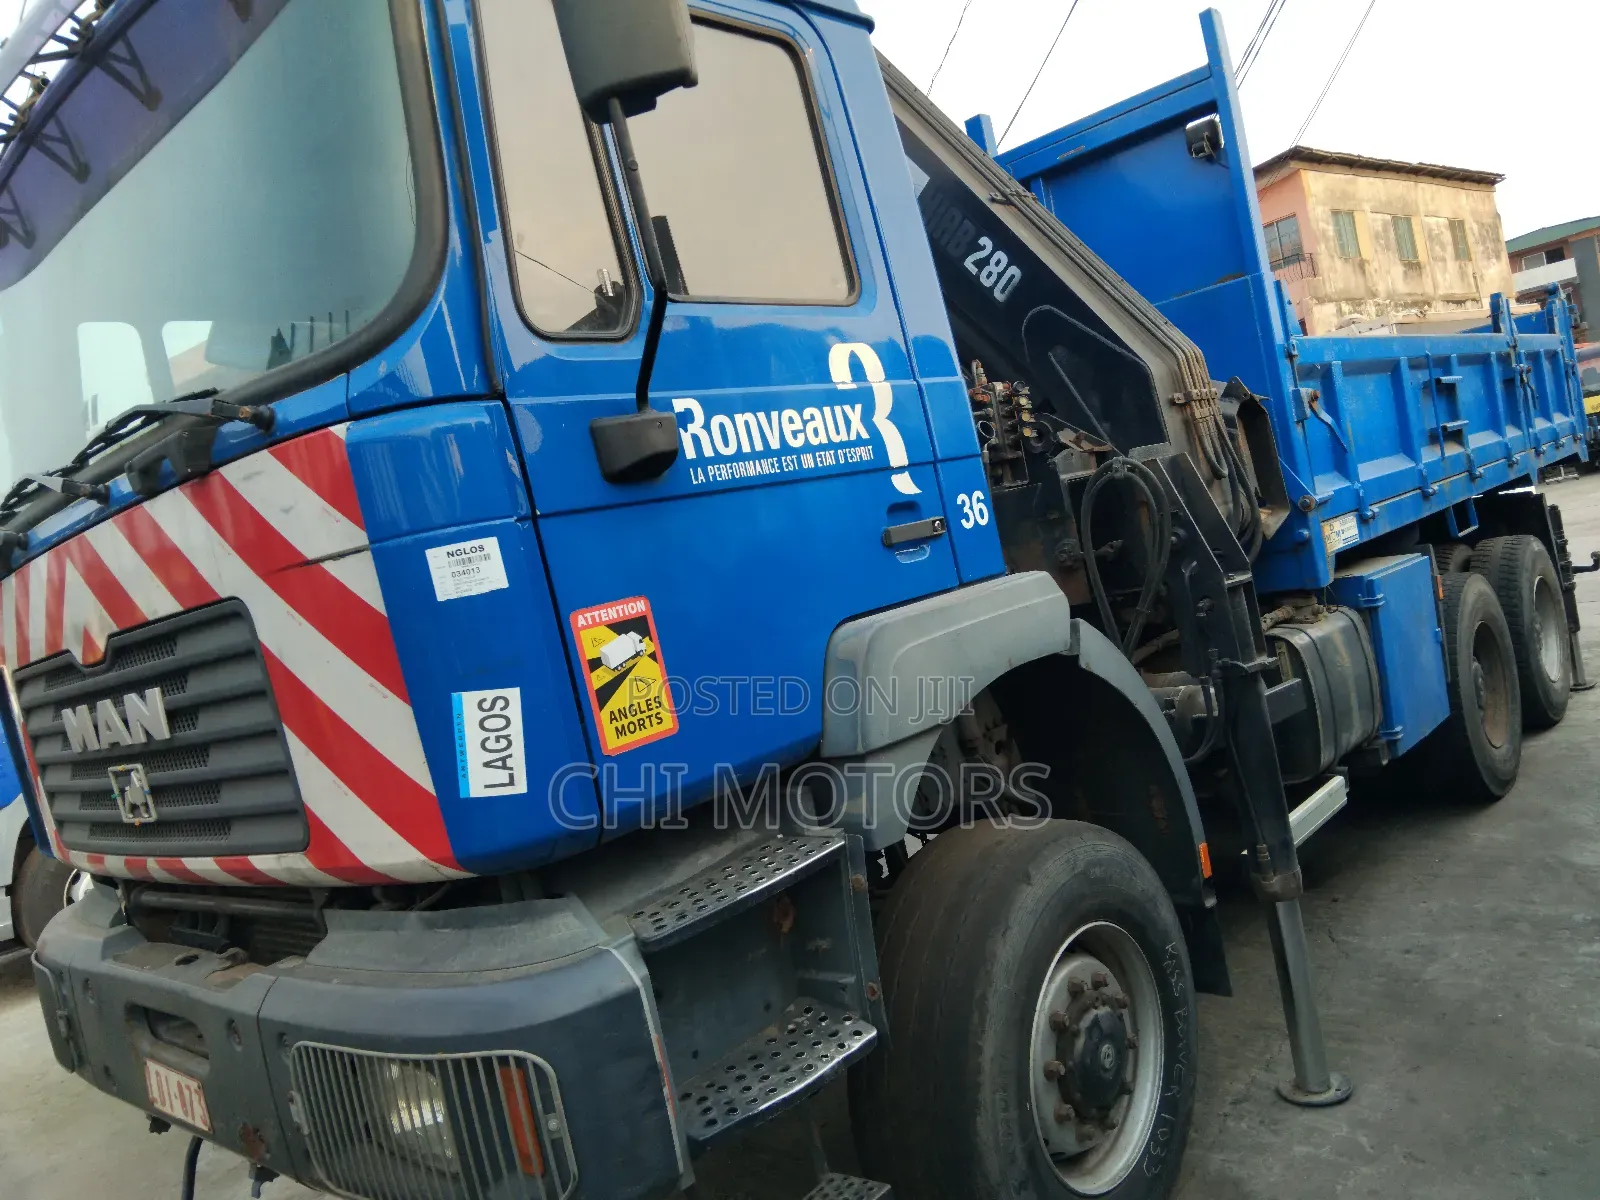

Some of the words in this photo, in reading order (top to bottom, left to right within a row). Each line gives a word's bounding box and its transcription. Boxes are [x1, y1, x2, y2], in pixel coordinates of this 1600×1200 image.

[963, 236, 1022, 302] 280
[671, 397, 871, 460] Ronveaux
[690, 466, 706, 485] LA
[708, 457, 780, 483] PERFORMANCE
[782, 454, 799, 471] EST
[800, 452, 815, 469] UN
[816, 449, 836, 468] ETAT
[838, 445, 875, 465] D'ESPRIT
[956, 490, 989, 530] 36
[446, 544, 486, 559] NGLOS
[451, 566, 481, 579] 034013
[576, 599, 647, 628] ATTENTION
[61, 686, 171, 754] MAN
[609, 695, 663, 725] ANGLES
[614, 712, 664, 740] MORTS
[477, 695, 516, 790] LAGOS
